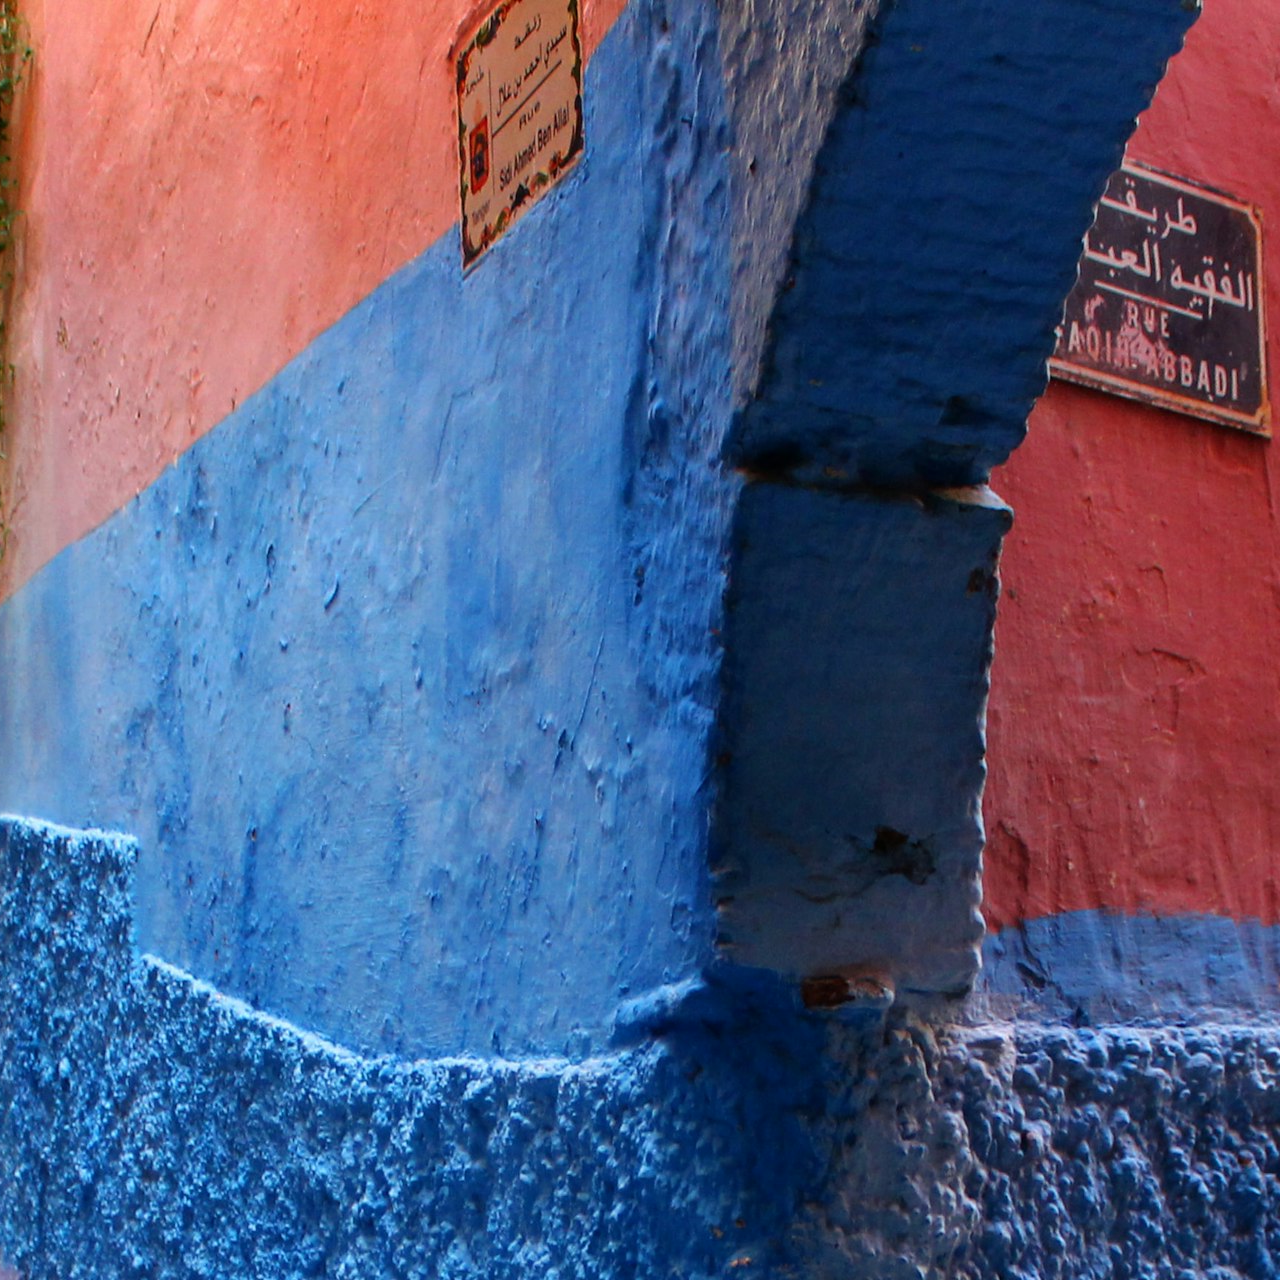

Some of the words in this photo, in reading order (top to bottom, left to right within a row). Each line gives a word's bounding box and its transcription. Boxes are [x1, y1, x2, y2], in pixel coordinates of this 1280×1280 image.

[514, 13, 541, 50] زنقة
[519, 101, 541, 130] Rue
[499, 160, 513, 192] Sidi
[514, 133, 537, 178] Ahmed
[537, 124, 552, 152] Ben
[1099, 177, 1197, 239] طريق
[1170, 257, 1255, 319] الفقيه
[1126, 301, 1170, 338] RUE
[1067, 320, 1131, 369] AQIH
